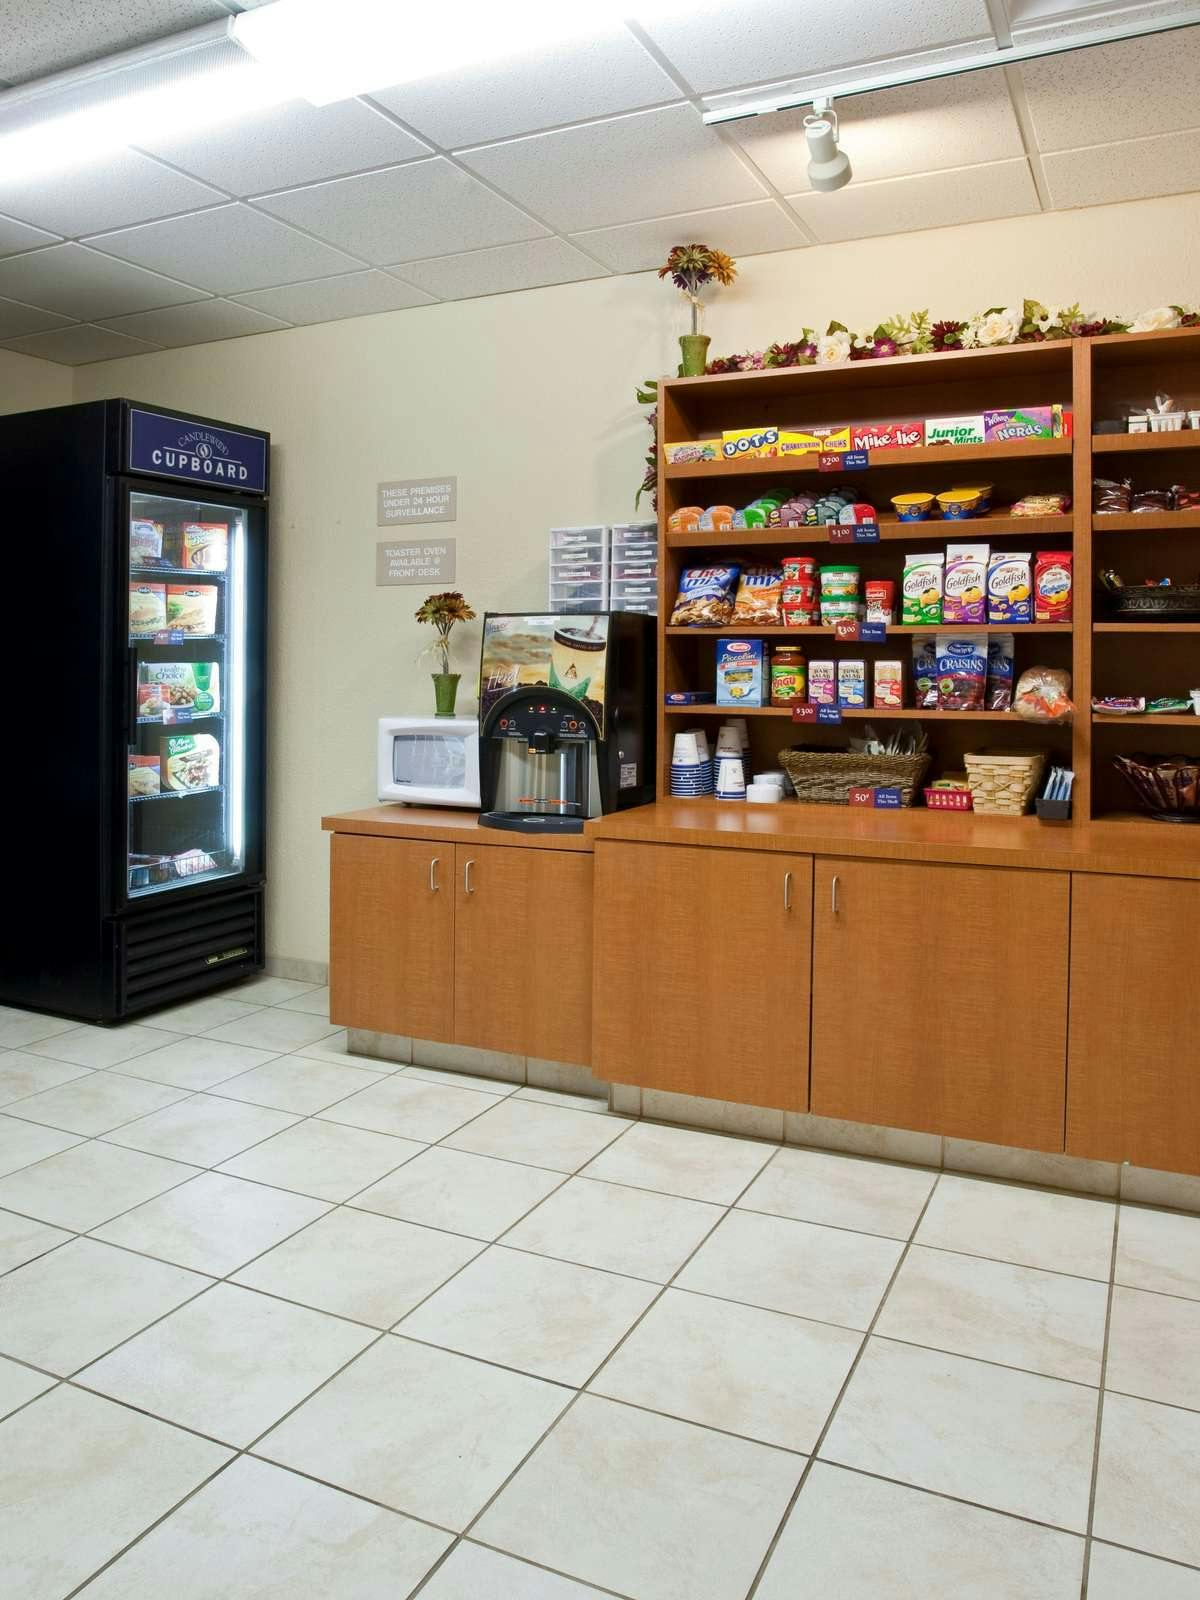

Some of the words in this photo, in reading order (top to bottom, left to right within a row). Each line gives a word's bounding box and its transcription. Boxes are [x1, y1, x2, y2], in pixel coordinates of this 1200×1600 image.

[928, 426, 975, 439] Junior
[725, 431, 778, 456] DOTS
[853, 433, 892, 450] Mike
[895, 430, 921, 446] Ike
[953, 435, 984, 444] Mints
[151, 449, 248, 480] CUPBOARD
[382, 488, 409, 497] THESE
[410, 485, 451, 496] PREMISES
[383, 498, 410, 508] UNDER
[413, 497, 424, 505] 24
[426, 495, 449, 504] HOUR
[385, 506, 447, 518] SURVEILLANCE
[385, 547, 421, 557] TOASTER
[423, 546, 447, 556] OVEN
[390, 557, 432, 568] AVAILABLE
[389, 568, 416, 577] FRONT
[418, 567, 441, 576] DESK
[904, 575, 938, 592] Goldfish
[946, 573, 982, 590] Goldfish
[991, 570, 1027, 588] Goldfish
[939, 657, 984, 672] CRAISINS
[155, 671, 186, 680] Choice
